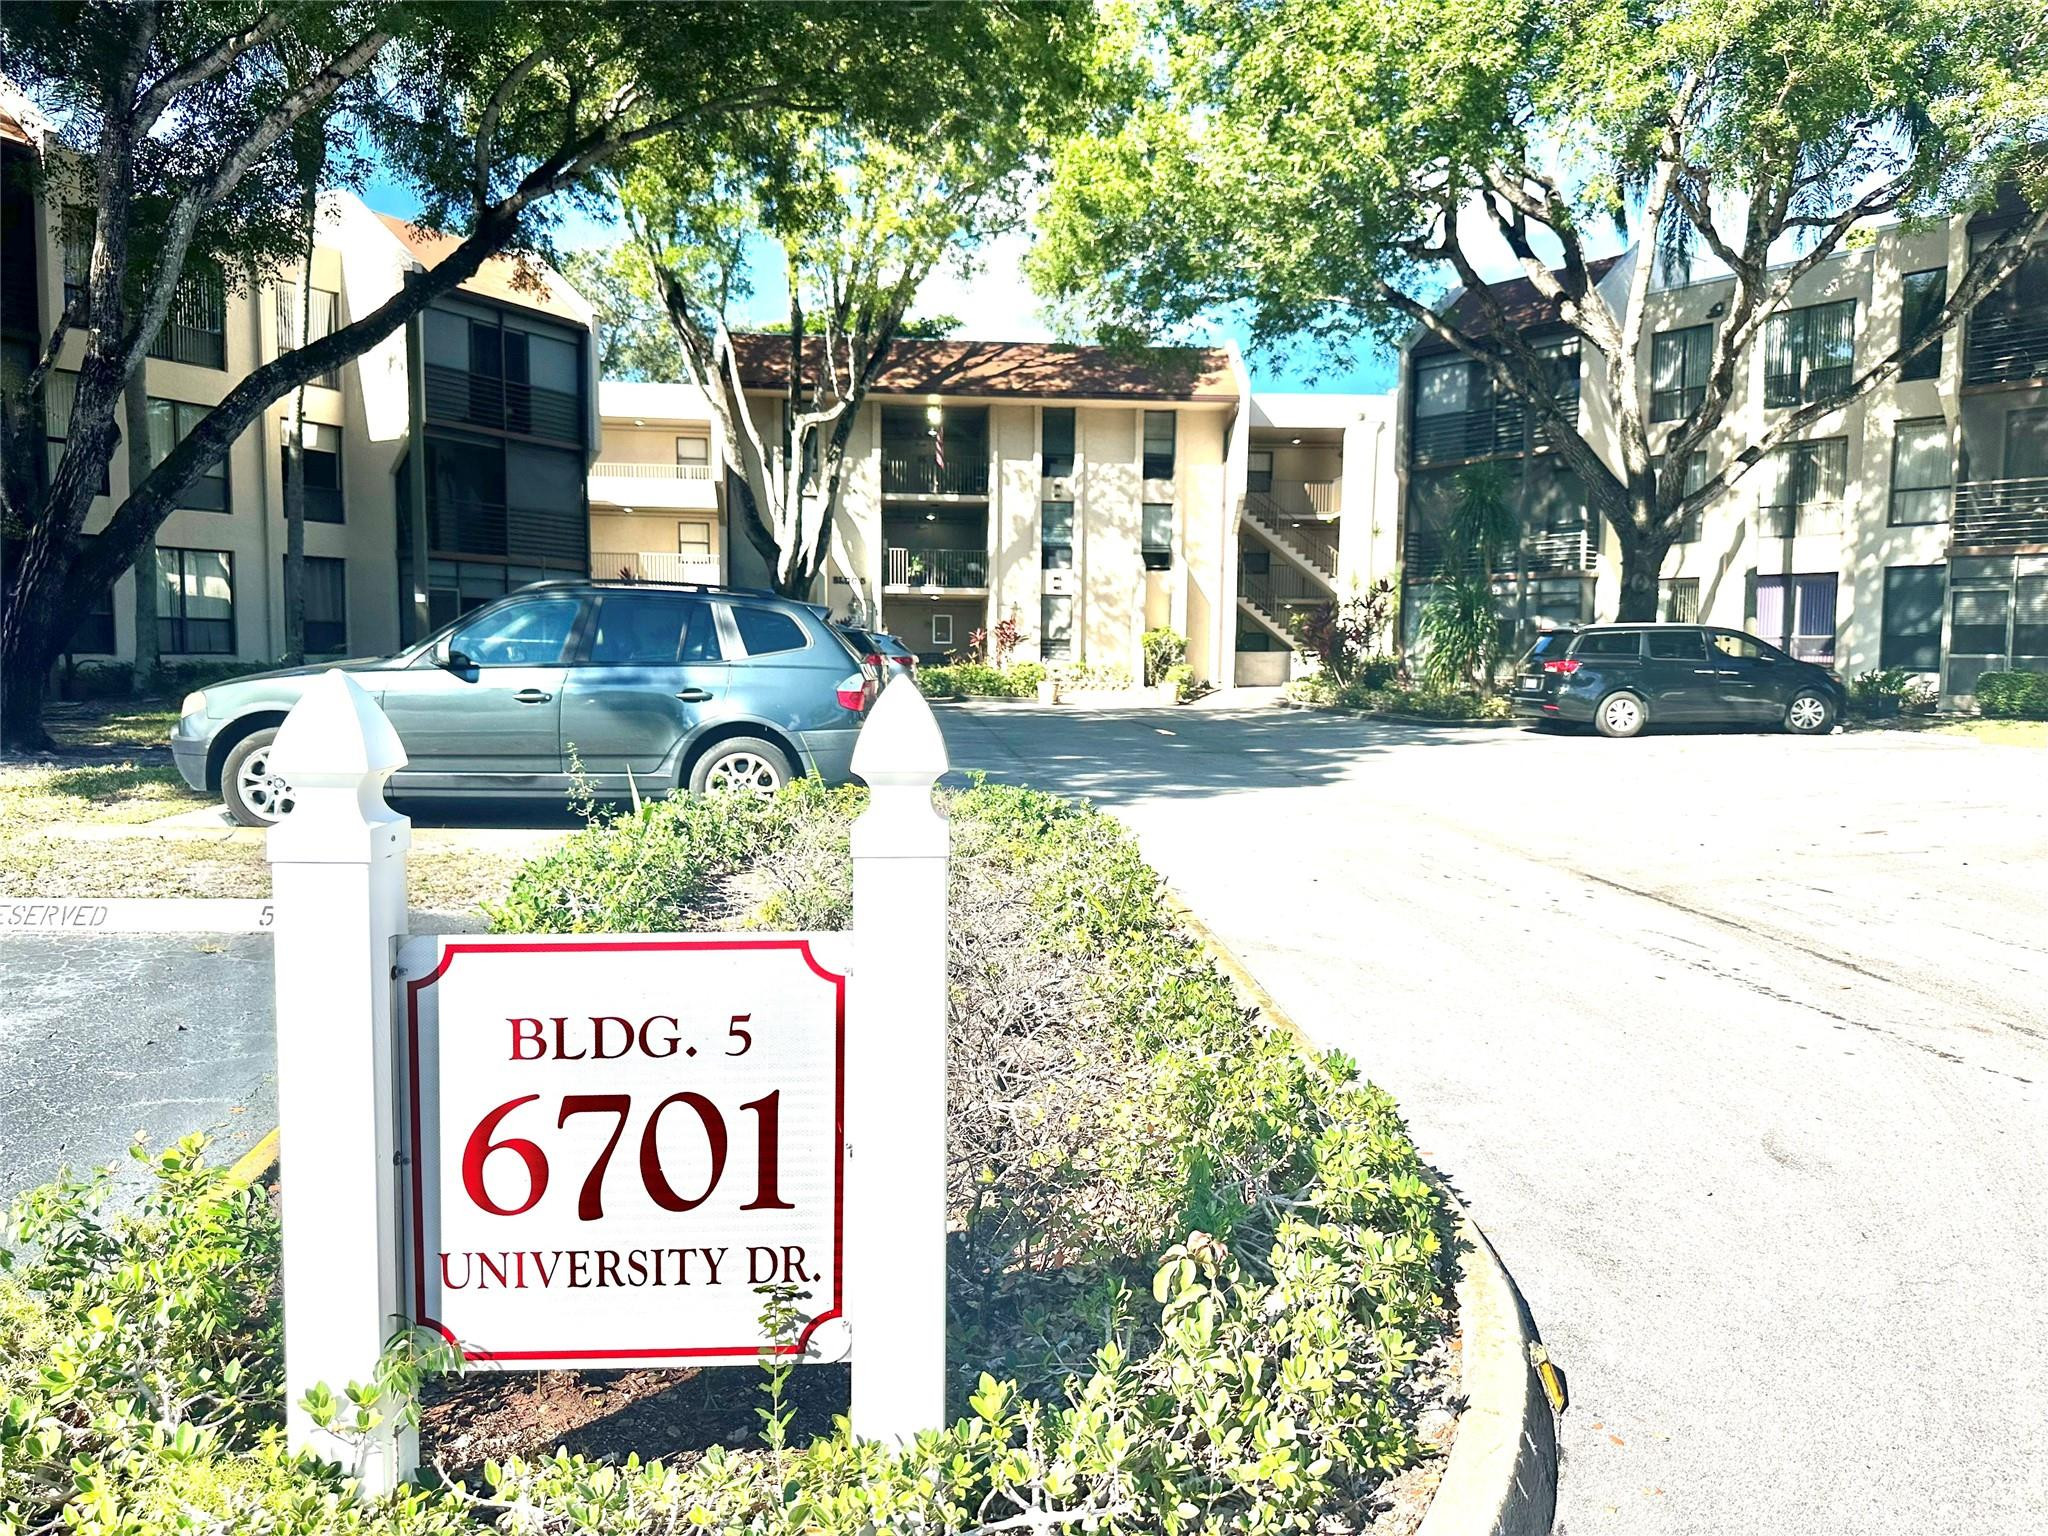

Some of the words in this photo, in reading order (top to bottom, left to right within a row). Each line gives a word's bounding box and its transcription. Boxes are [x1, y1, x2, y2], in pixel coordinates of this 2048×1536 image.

[505, 1015, 697, 1061] BLDG.
[725, 1012, 752, 1057] 5
[462, 1089, 795, 1221] 6701
[439, 1247, 728, 1290] UNIVERSITY
[746, 1246, 822, 1284] DR.
